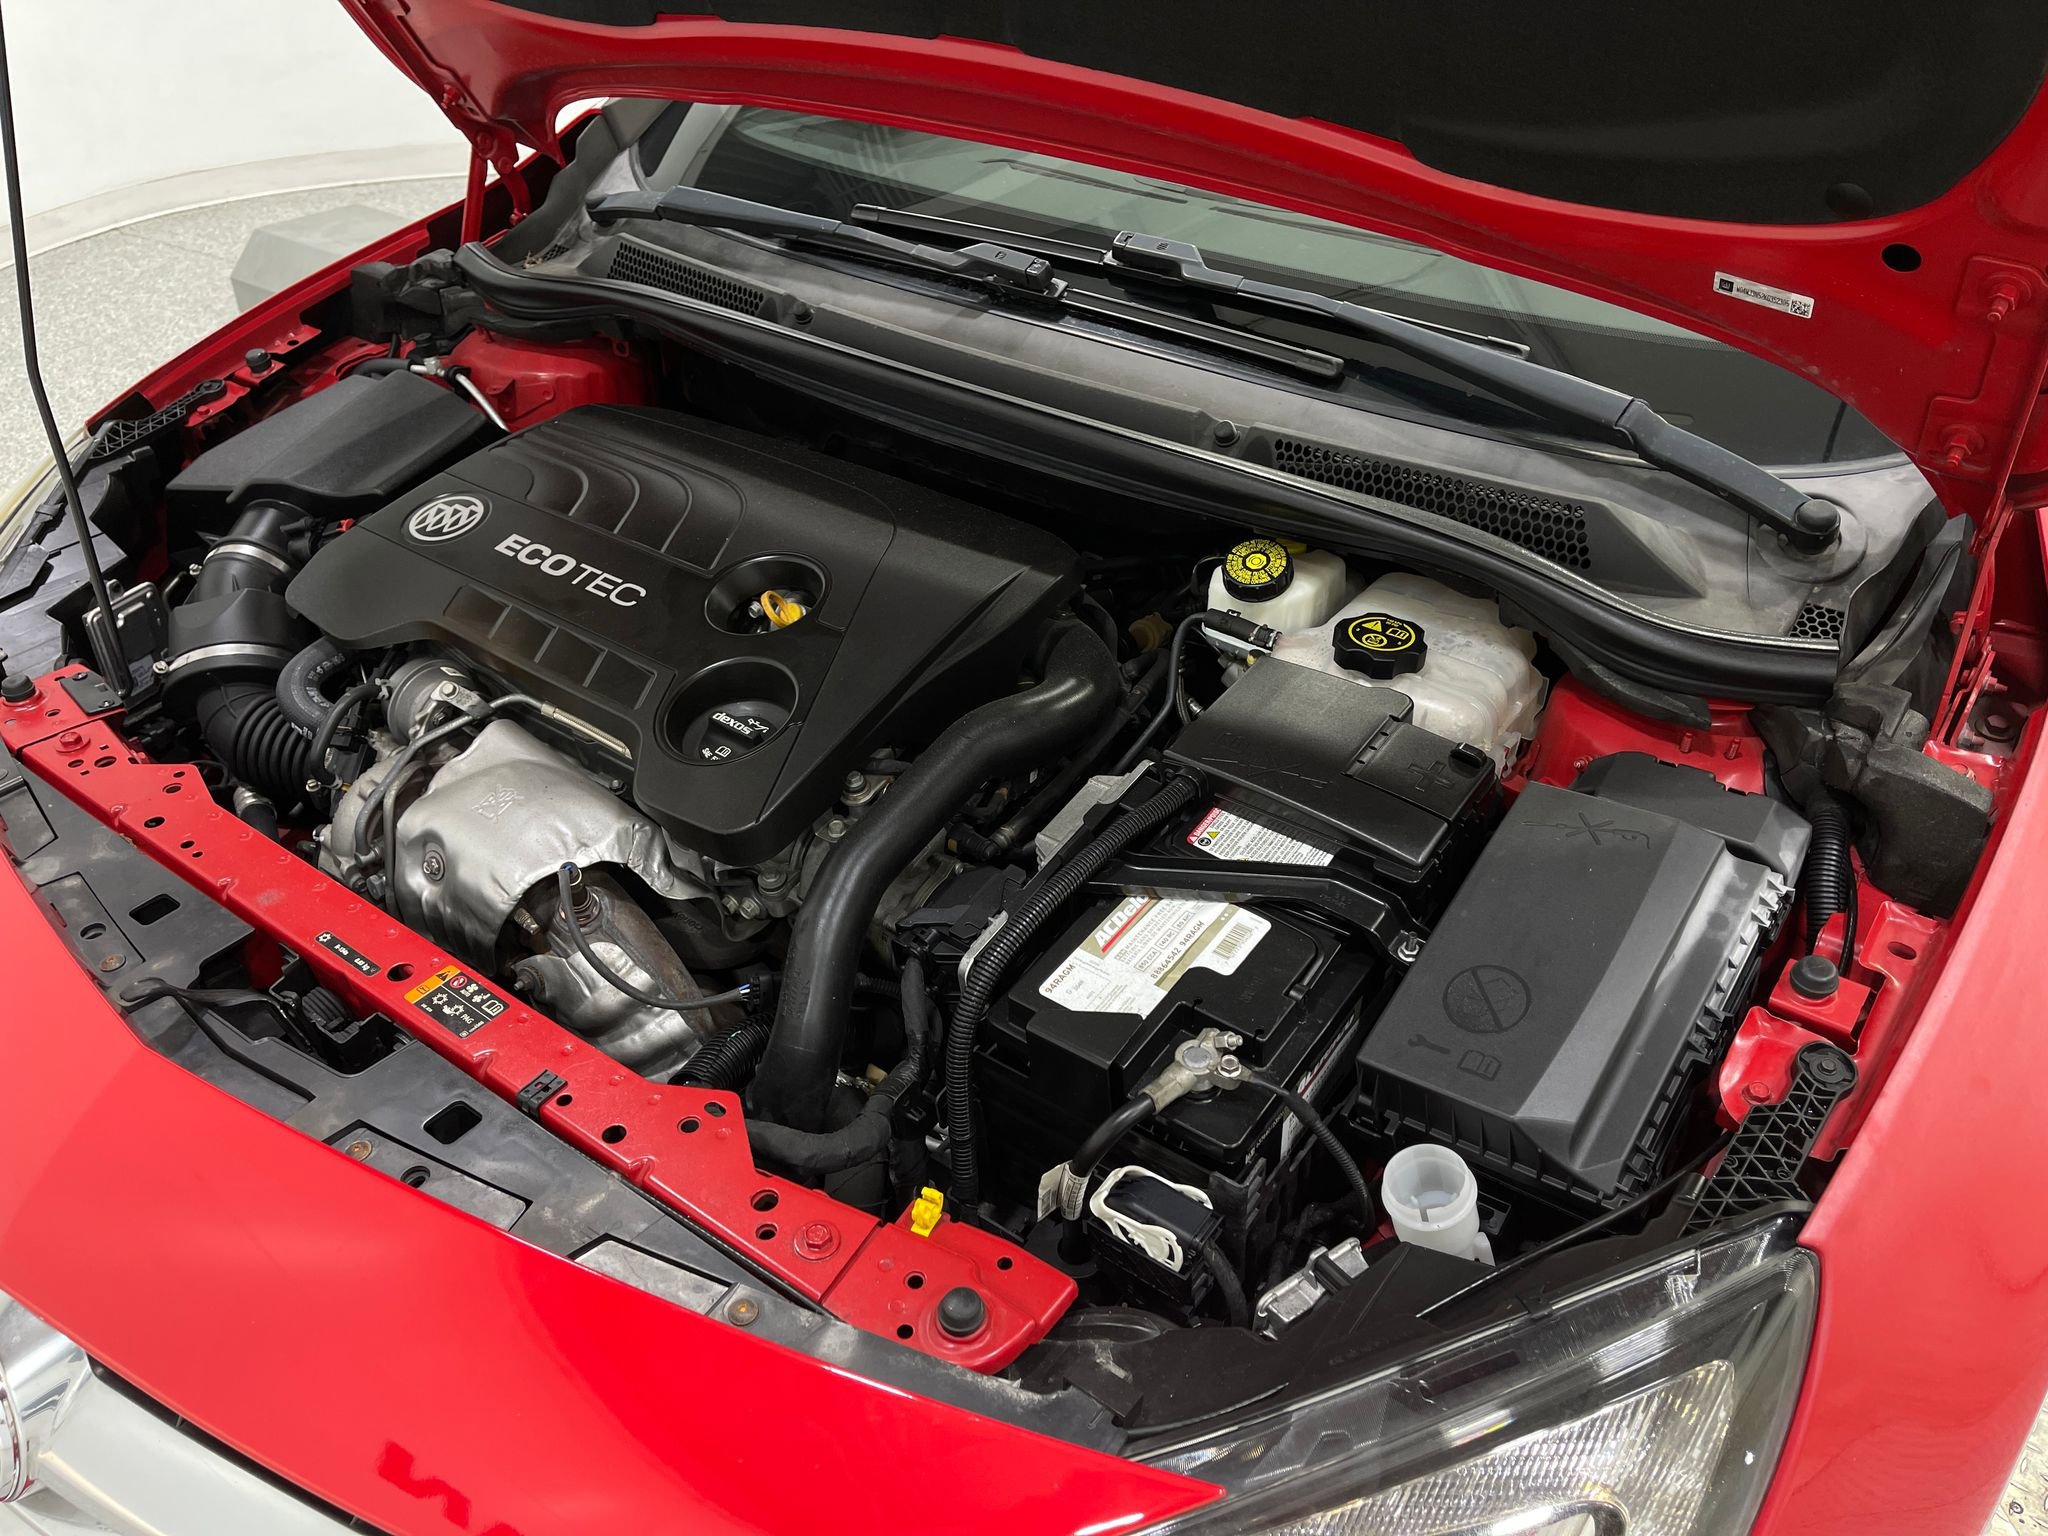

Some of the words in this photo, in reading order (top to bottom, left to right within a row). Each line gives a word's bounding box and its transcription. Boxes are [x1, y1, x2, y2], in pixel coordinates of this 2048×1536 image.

[494, 533, 646, 607] ECOTEC
[712, 712, 754, 735] dexos
[1179, 920, 1205, 946] 94RAGM
[1044, 963, 1076, 994] 94RAGM
